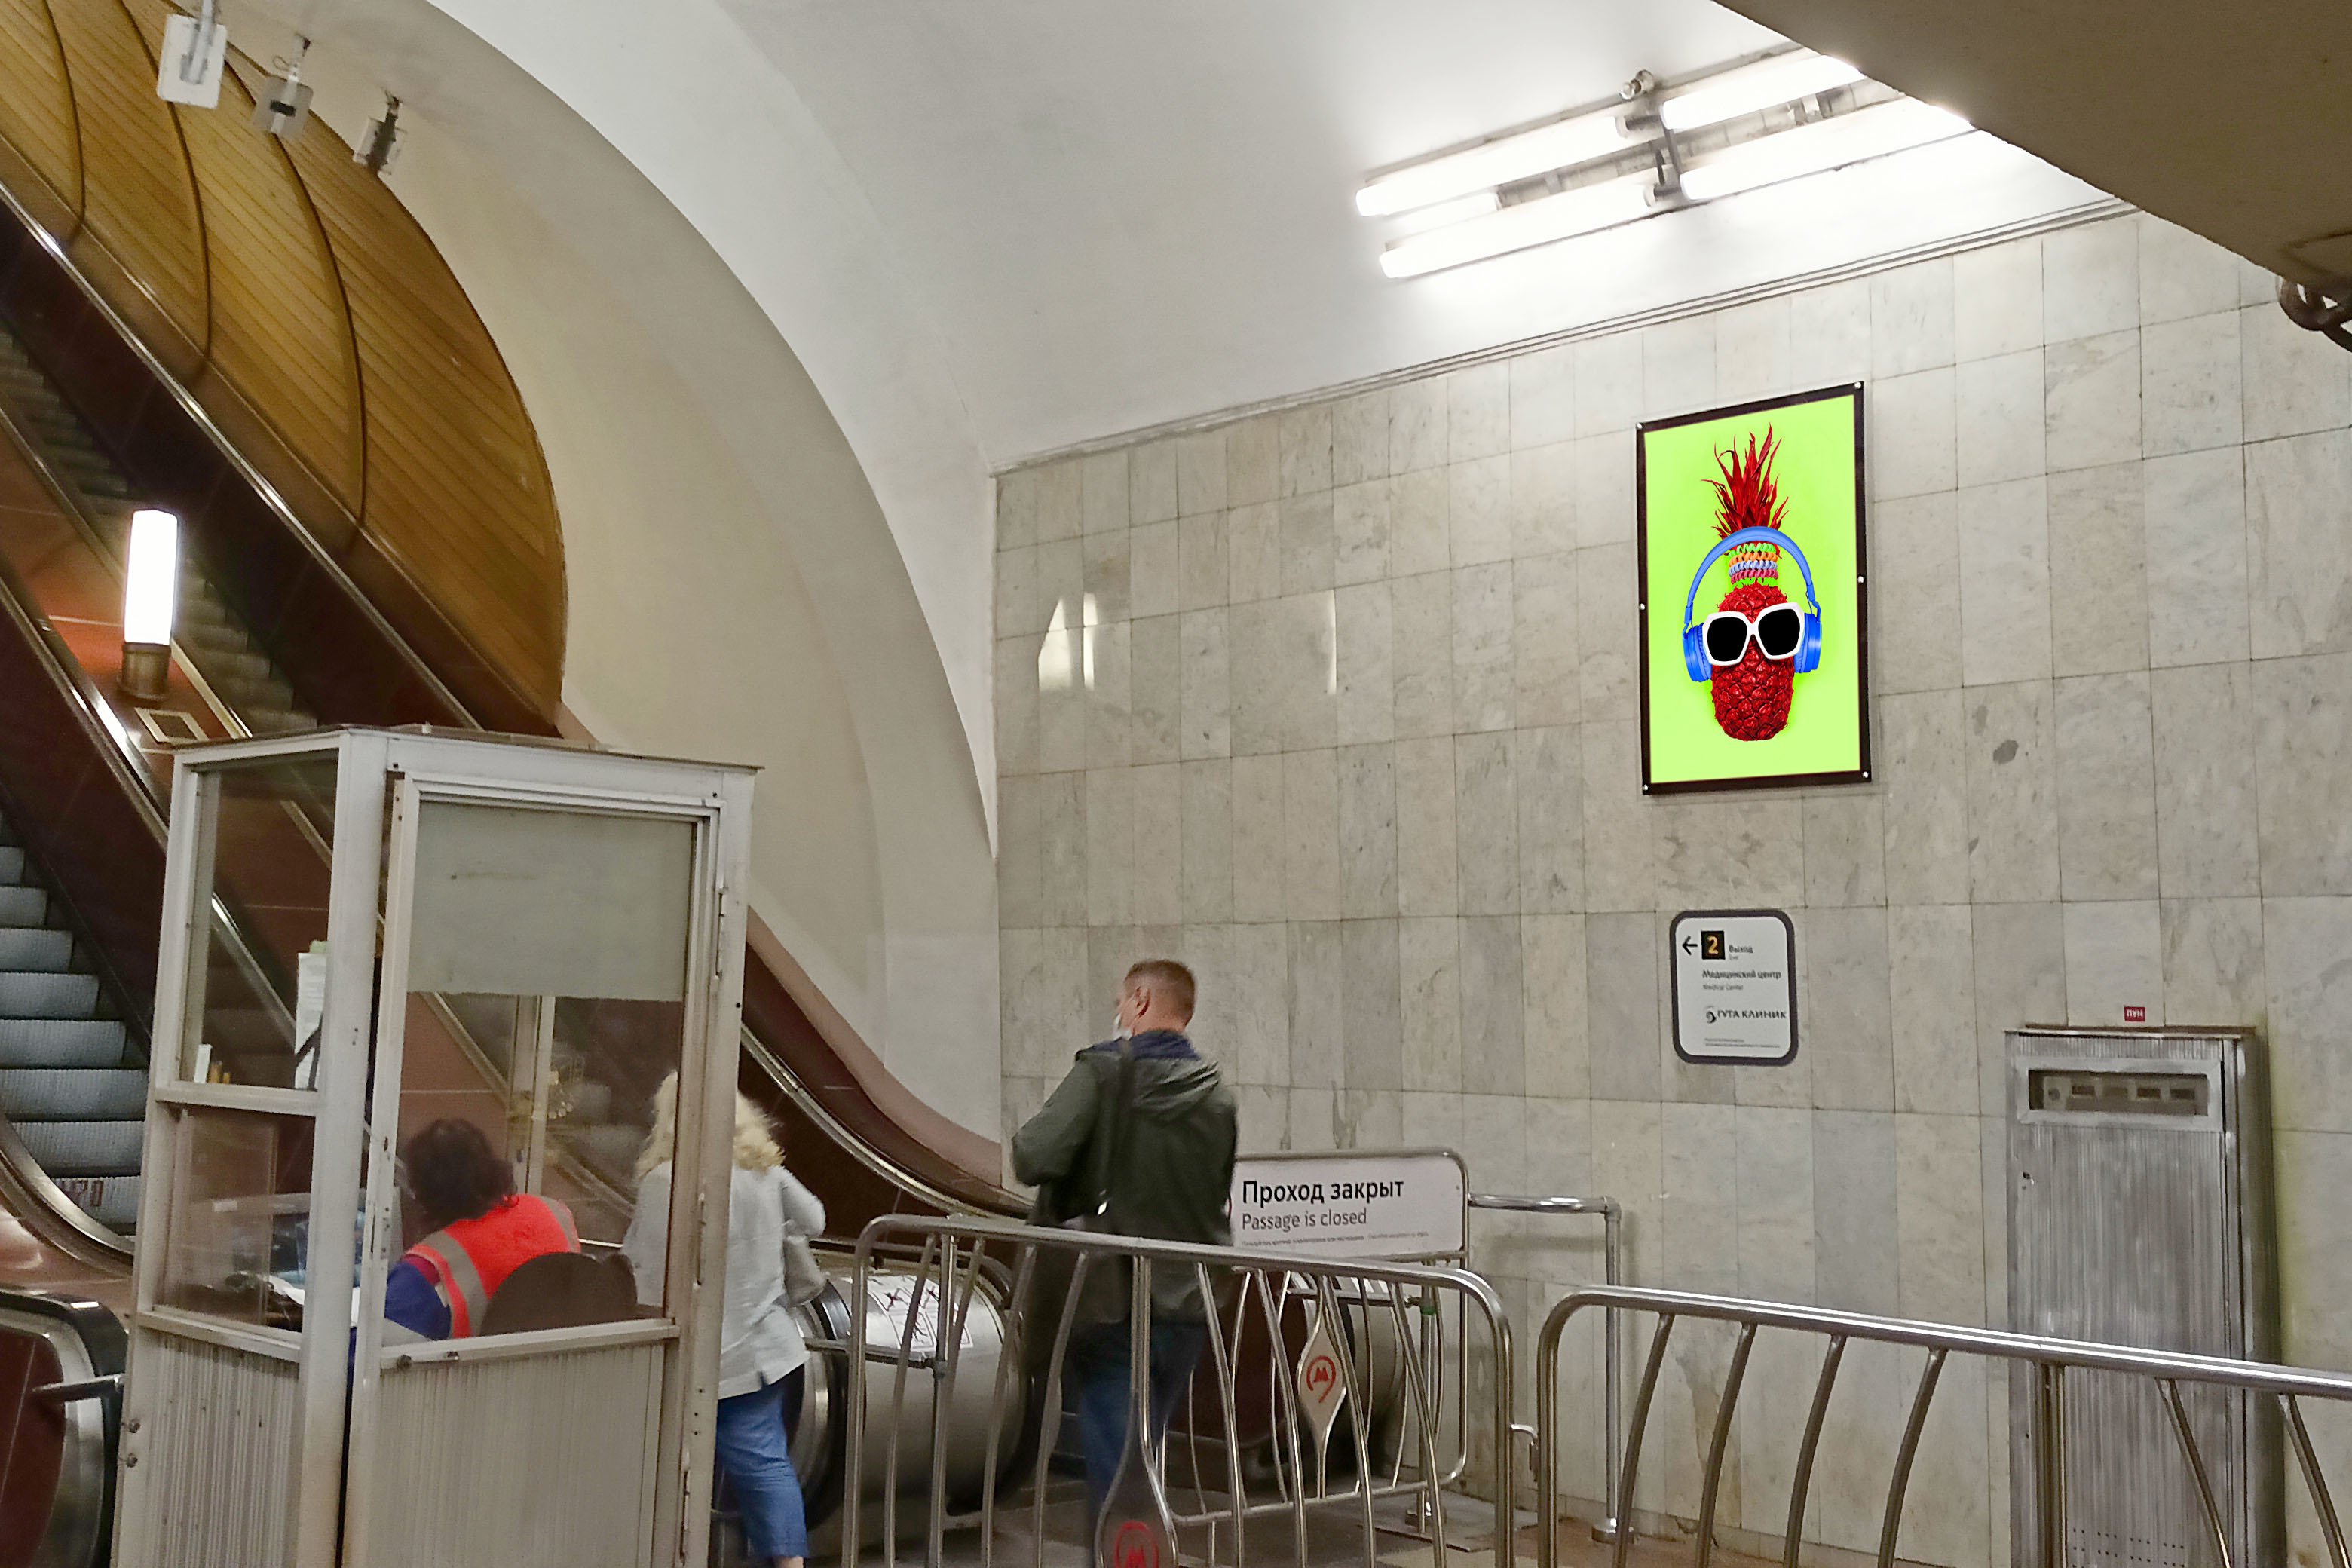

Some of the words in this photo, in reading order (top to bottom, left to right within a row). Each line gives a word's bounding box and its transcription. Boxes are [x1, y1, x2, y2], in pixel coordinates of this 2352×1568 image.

[1707, 936, 1719, 954] 2
[1741, 1010, 1787, 1019] КЛИНИК
[1242, 1181, 1325, 1208] Проход
[1330, 1181, 1404, 1203] закрыт
[1242, 1211, 1300, 1232] Passage
[1305, 1210, 1316, 1227] is
[1320, 1208, 1367, 1227] closed
